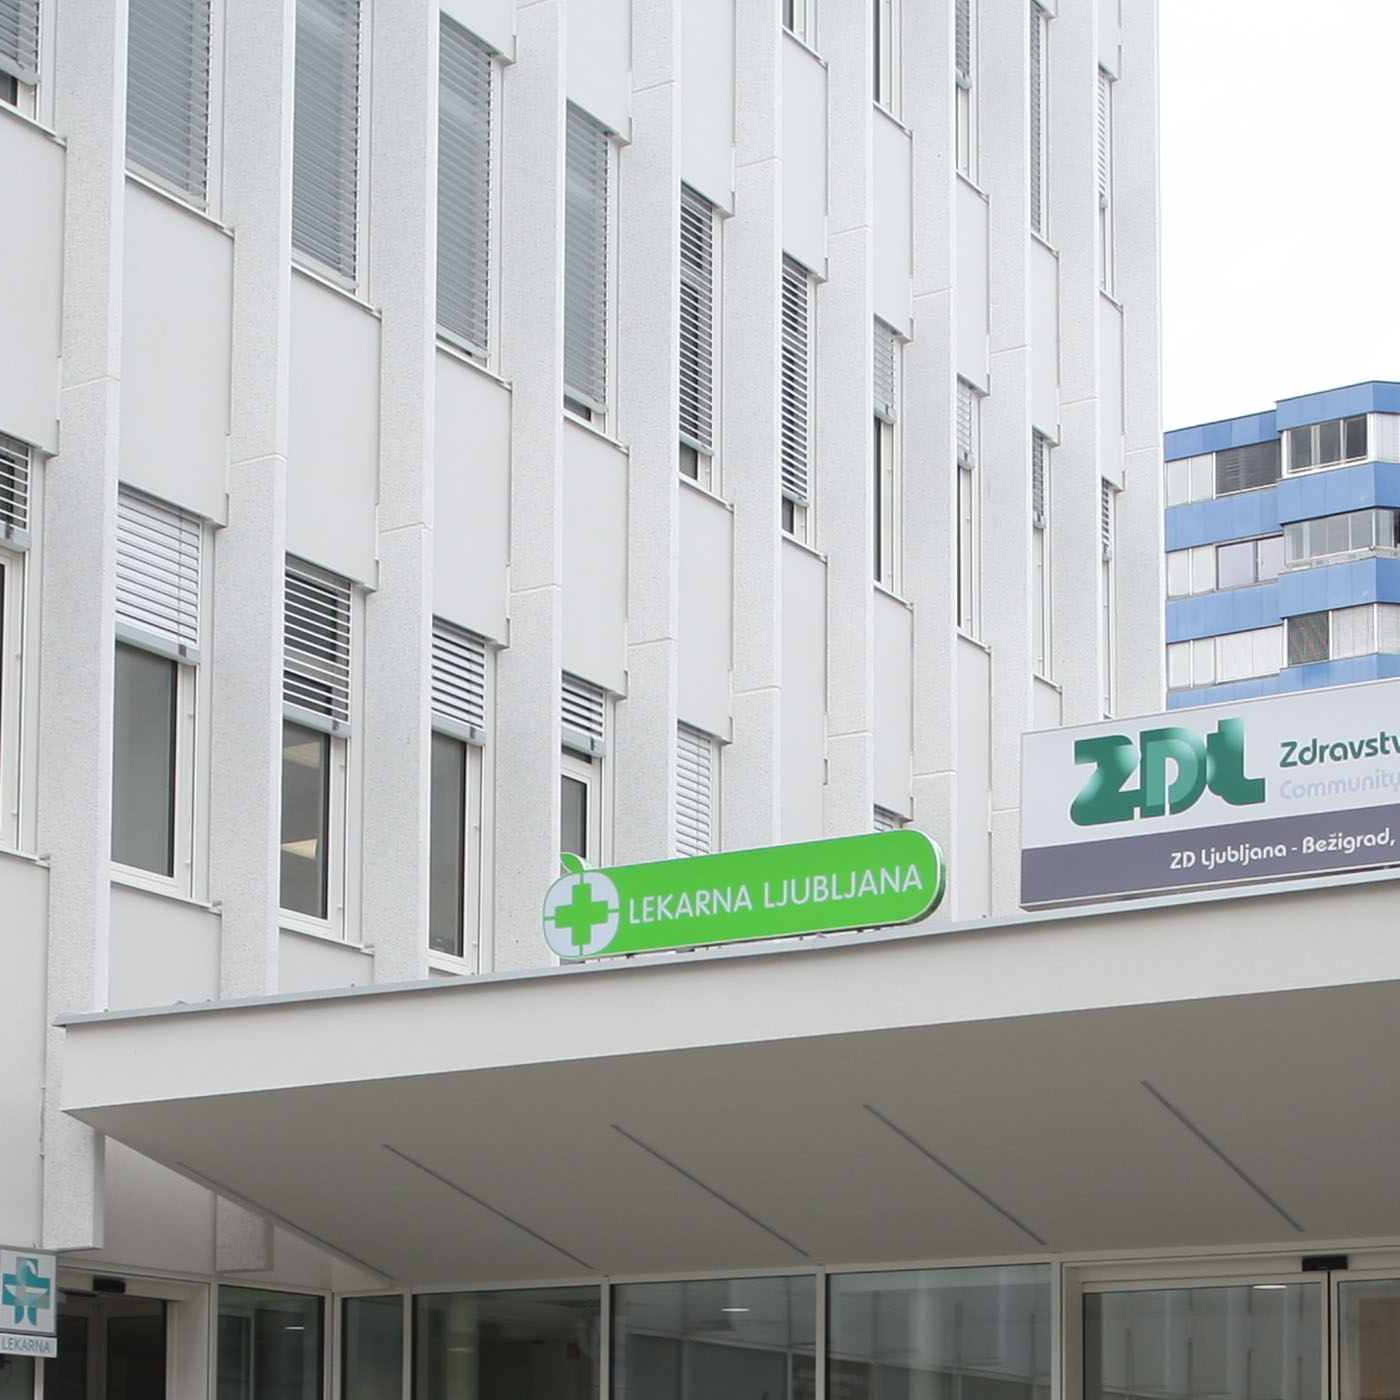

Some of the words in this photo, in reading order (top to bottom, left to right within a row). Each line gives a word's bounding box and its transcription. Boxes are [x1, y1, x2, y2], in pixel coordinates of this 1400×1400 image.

[1070, 716, 1266, 826] ZDL
[1169, 851, 1196, 870] ZD
[1201, 843, 1287, 870] Ljubljana
[1302, 828, 1396, 855] Bežigrad,
[629, 884, 753, 924] LEKARNA
[763, 863, 923, 909] LJUBLJANA
[1, 1337, 52, 1354] LEKARNA
